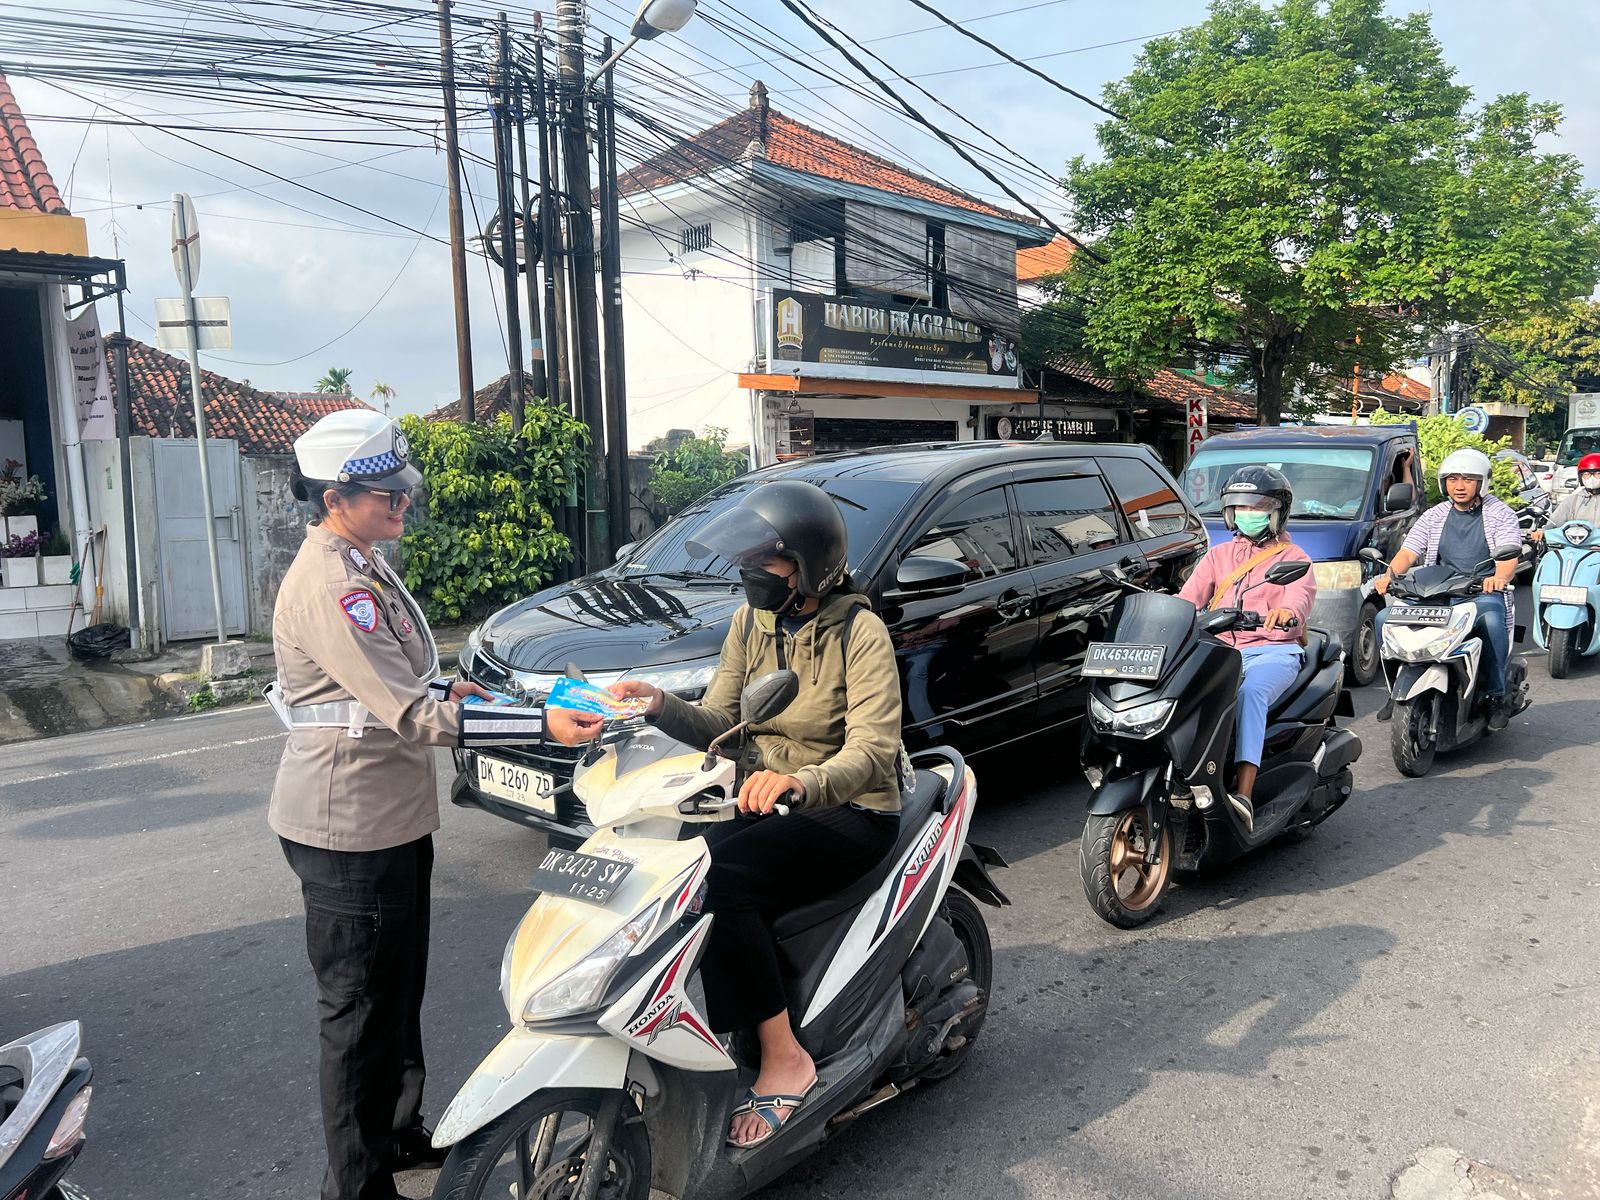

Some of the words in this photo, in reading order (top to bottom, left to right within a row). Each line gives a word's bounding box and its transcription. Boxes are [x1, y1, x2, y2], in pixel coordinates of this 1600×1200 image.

[824, 302, 886, 331] HABIBI
[890, 310, 982, 342] FRAGRANCE
[904, 340, 933, 351] Aromatic
[933, 343, 944, 353] Spa
[1056, 420, 1096, 435] TIMBUL
[480, 760, 495, 782] DK
[500, 765, 529, 792] 1269
[538, 851, 565, 872] DK
[559, 855, 598, 878] 3413
[598, 863, 628, 884] SW
[628, 994, 675, 1035] HONDA
